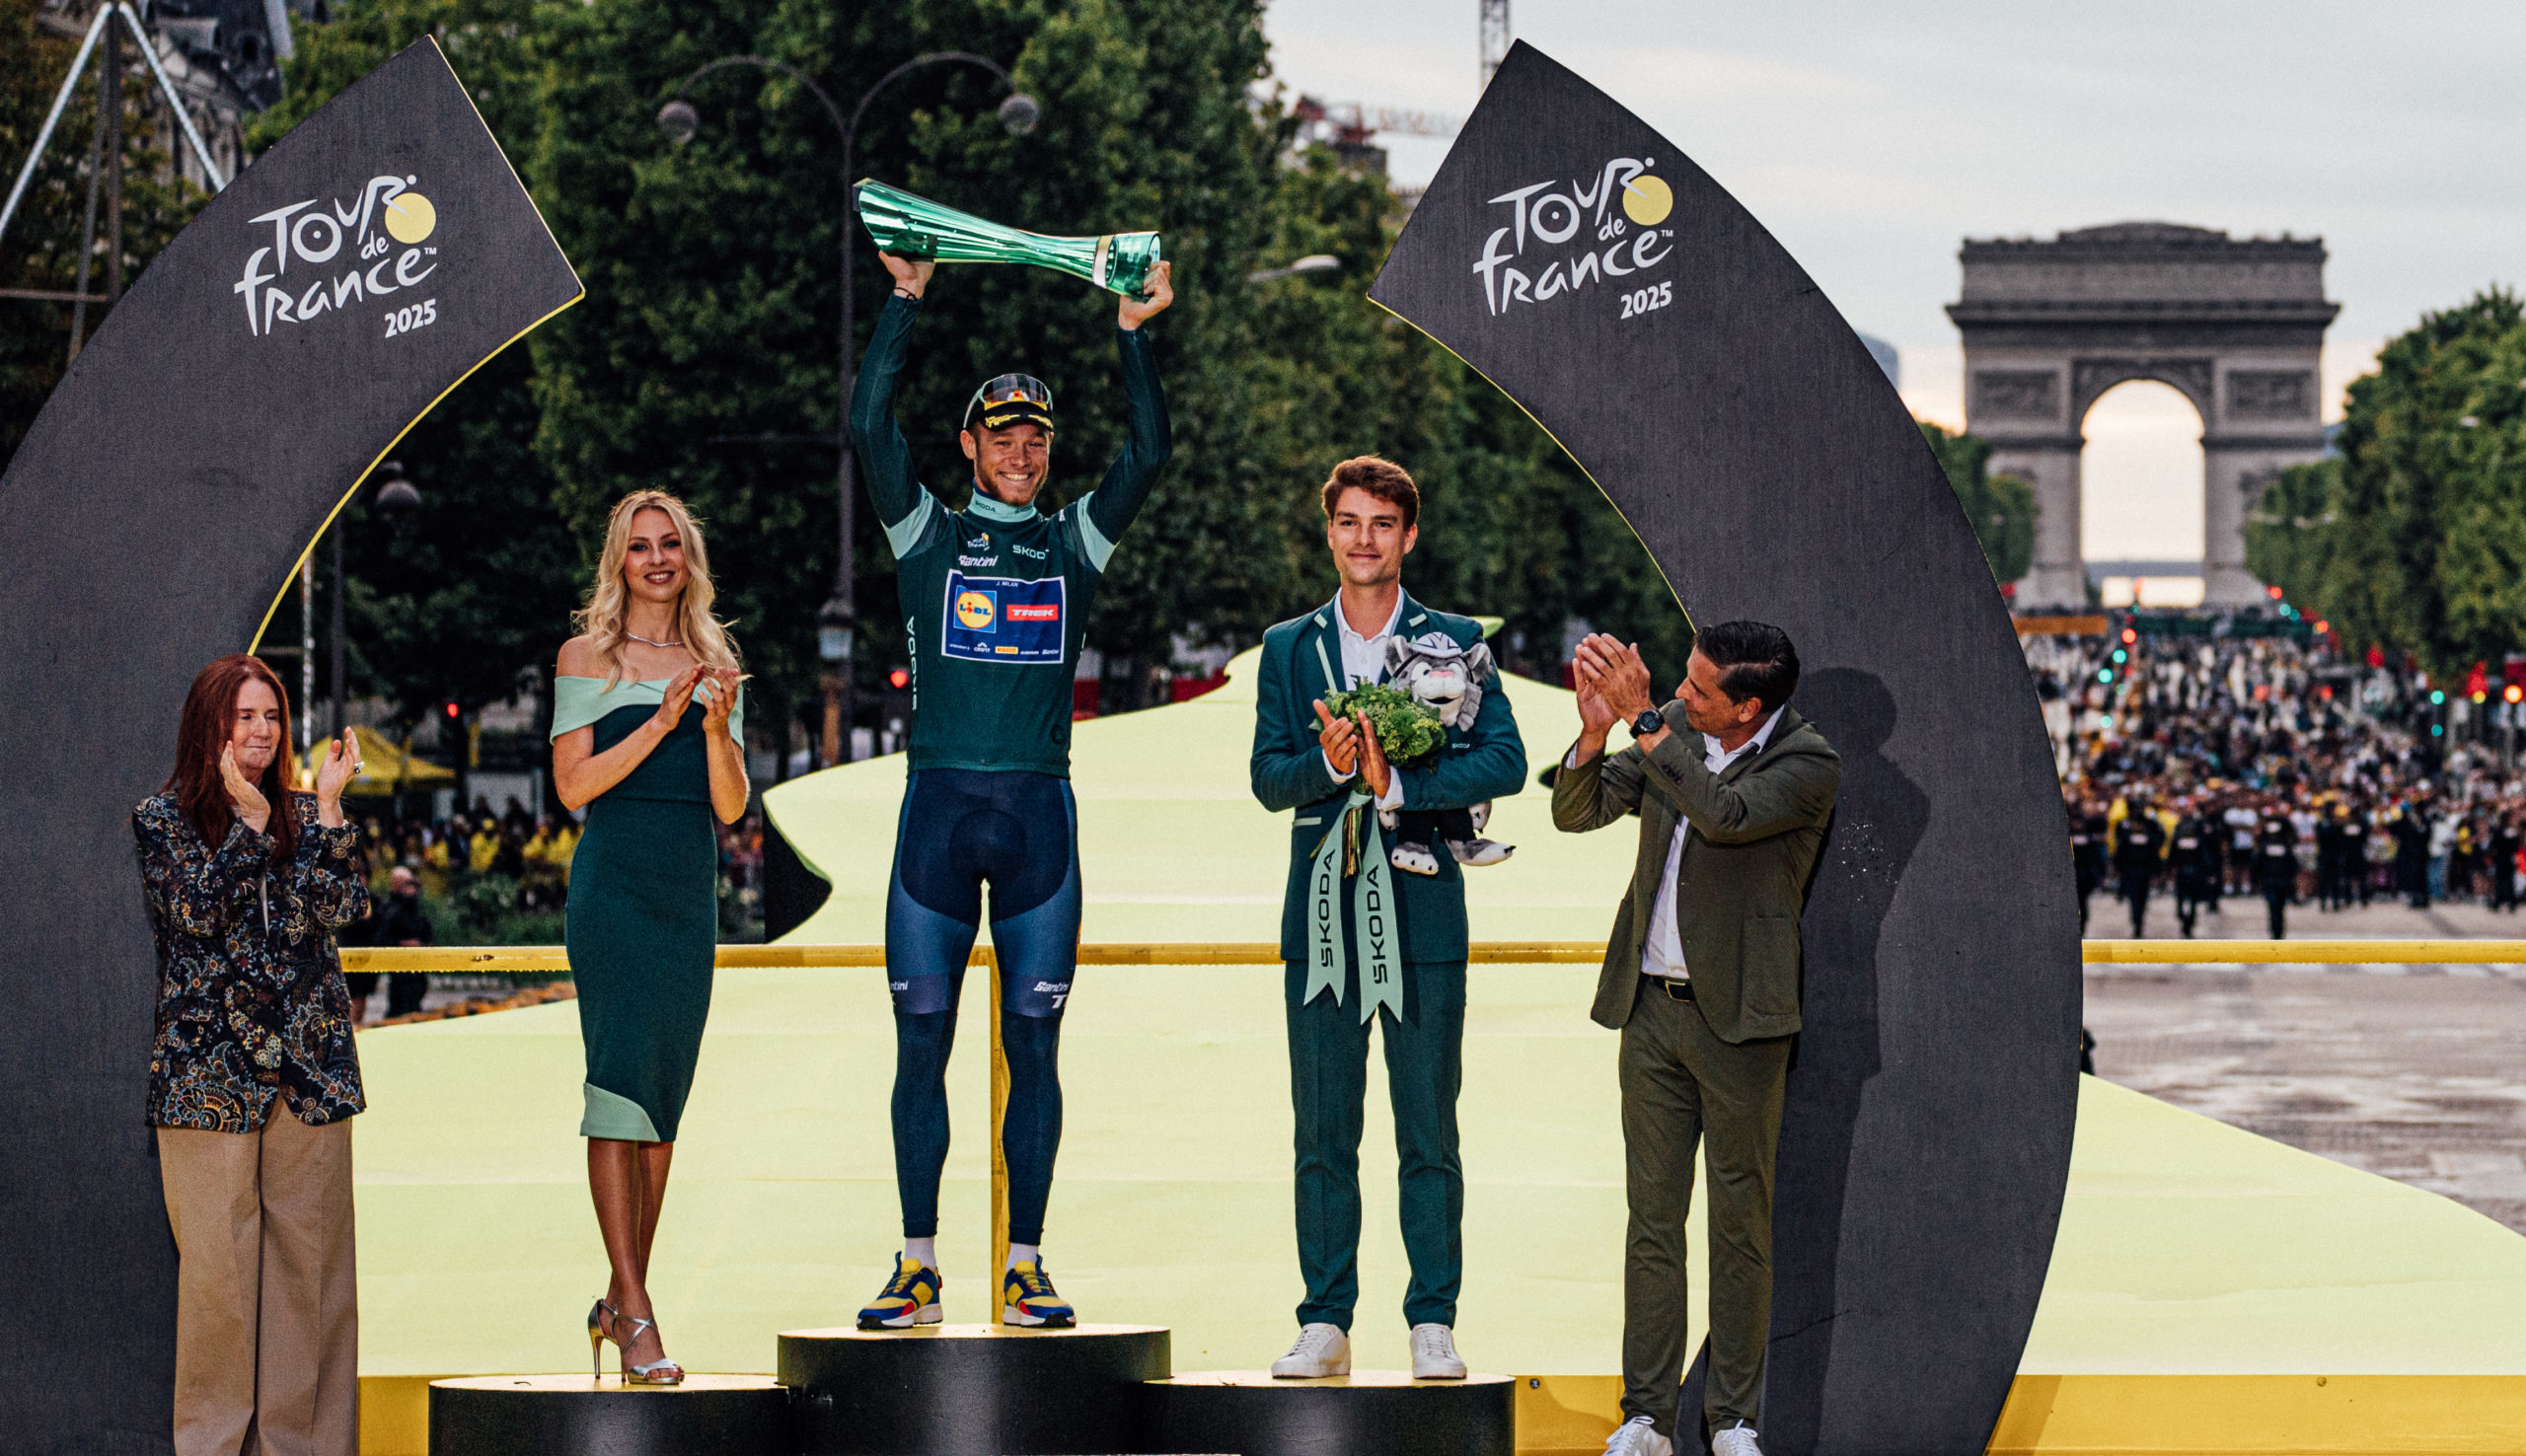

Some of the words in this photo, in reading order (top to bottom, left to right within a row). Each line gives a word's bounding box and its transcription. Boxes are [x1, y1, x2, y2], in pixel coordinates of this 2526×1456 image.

[1598, 212, 1626, 241] de
[361, 230, 389, 259] de
[1621, 281, 1672, 320] 2025
[385, 299, 437, 338] 2025
[958, 554, 999, 566] Santini
